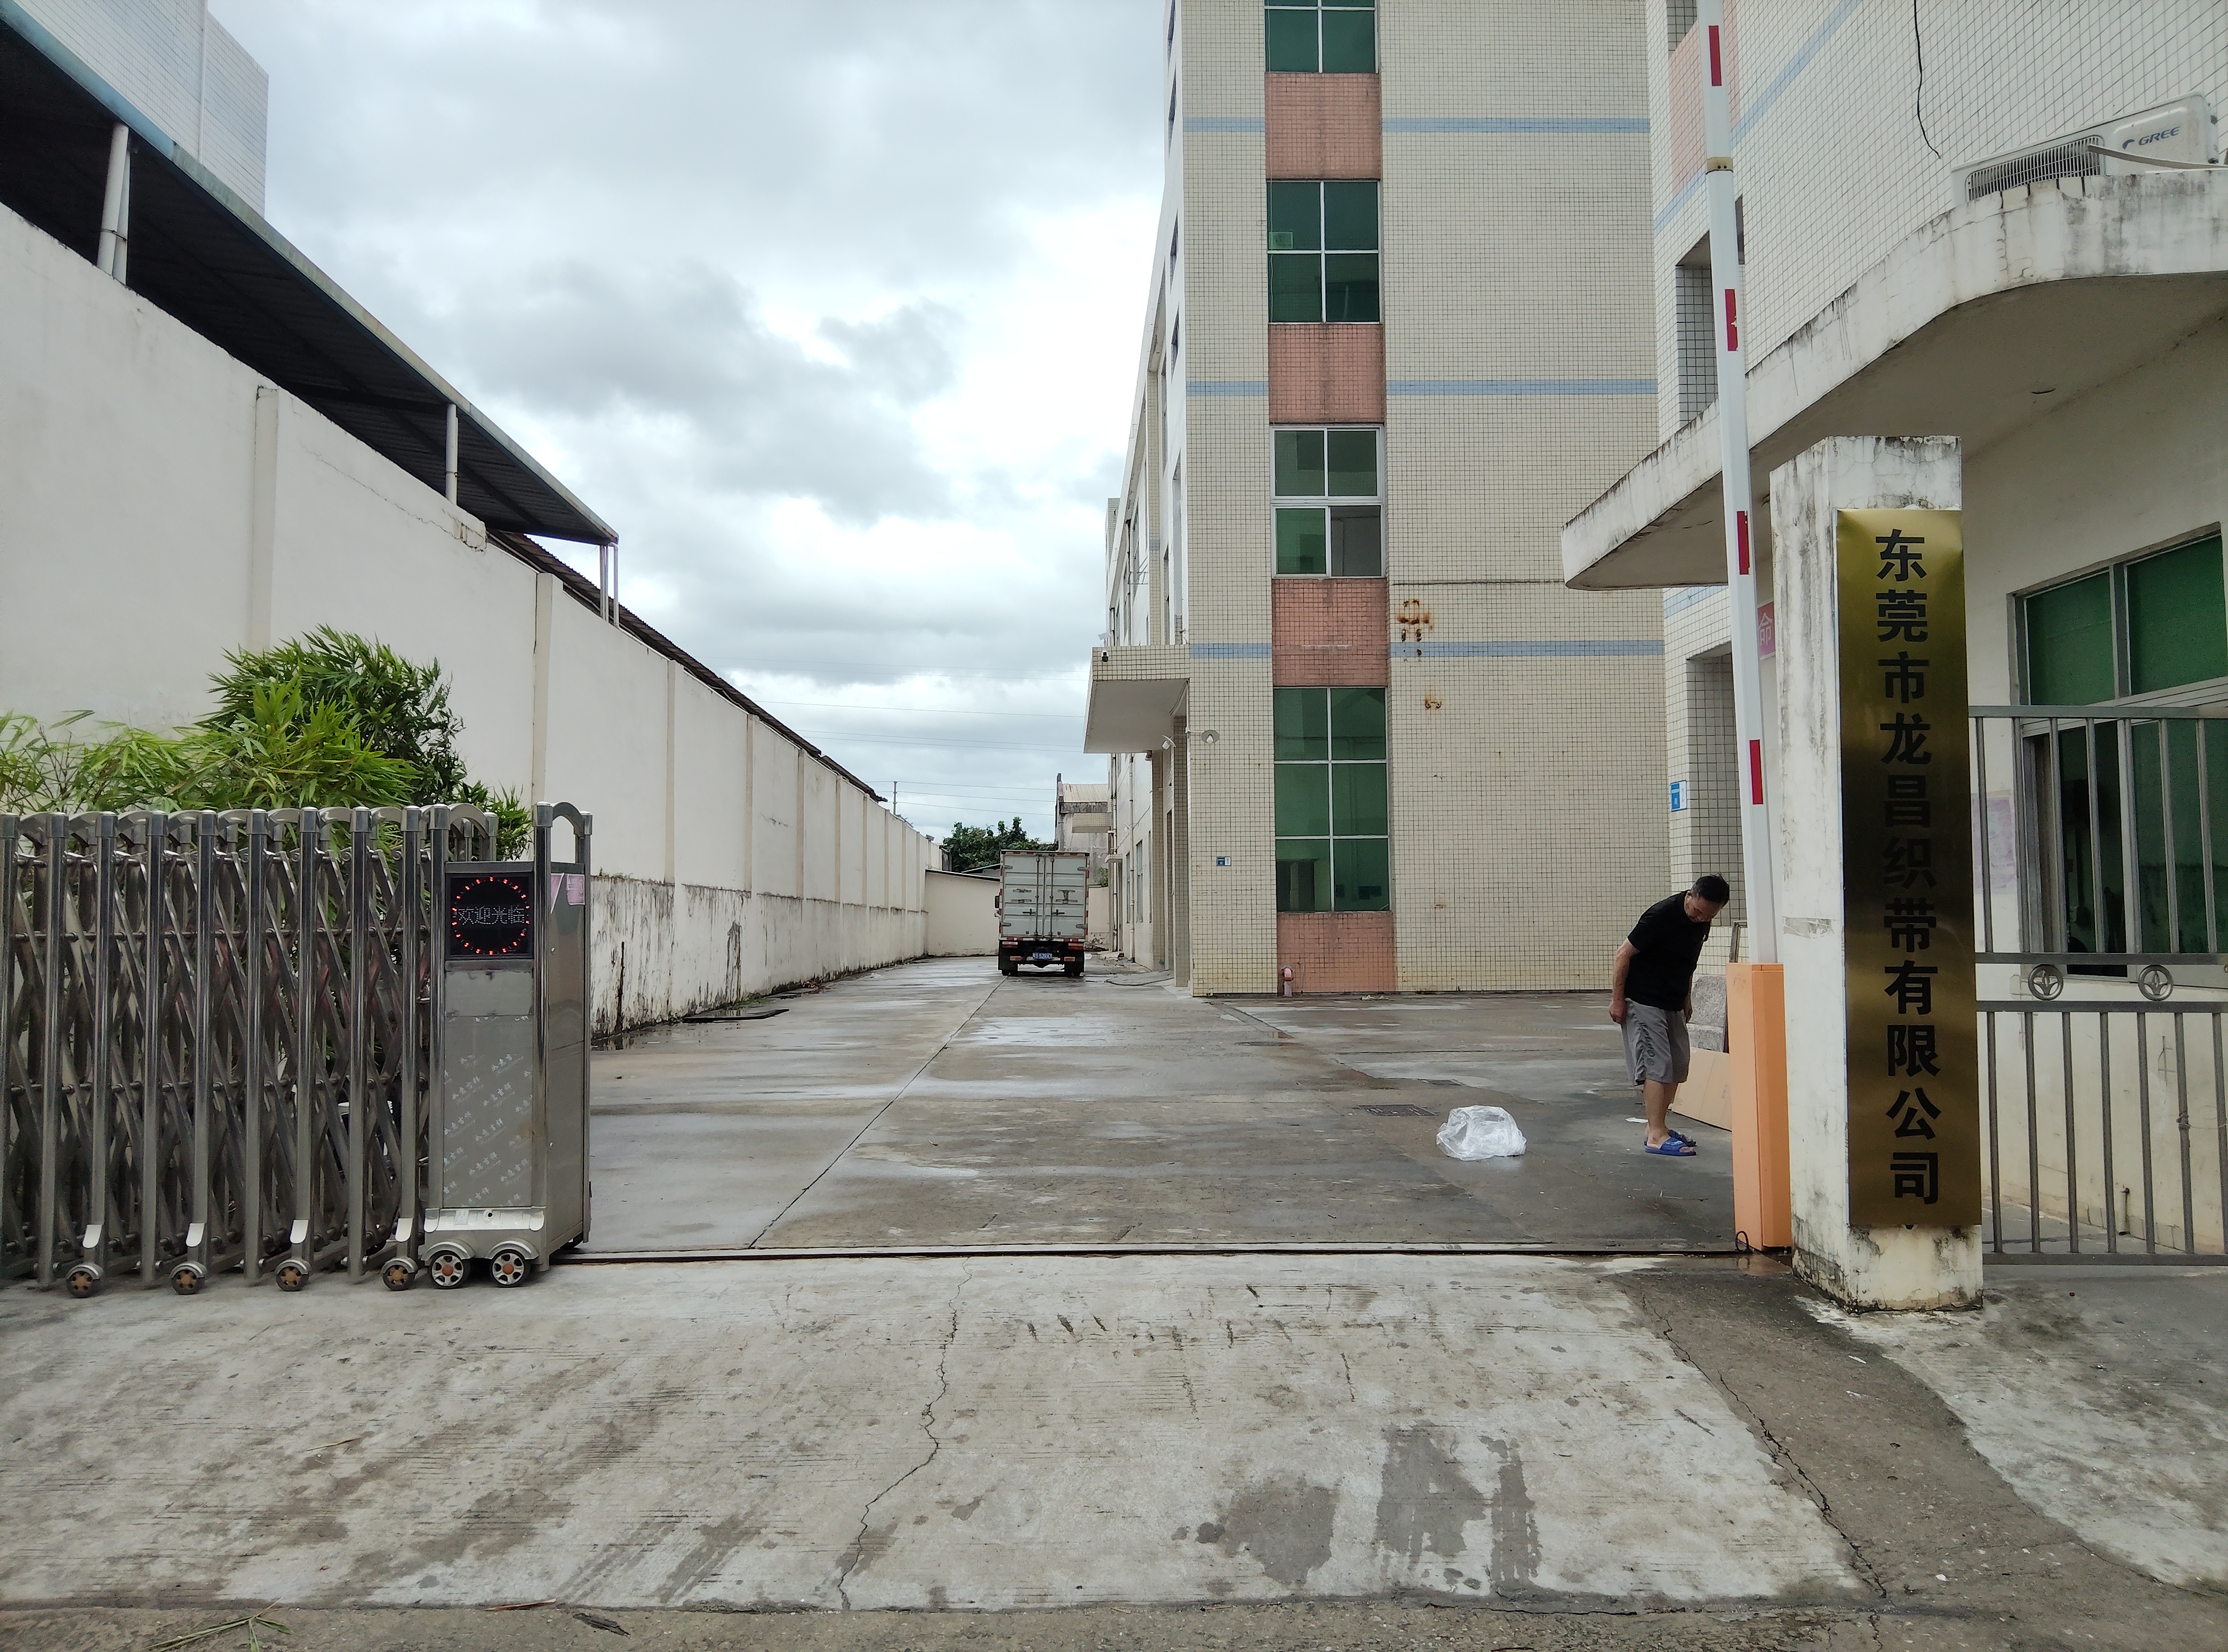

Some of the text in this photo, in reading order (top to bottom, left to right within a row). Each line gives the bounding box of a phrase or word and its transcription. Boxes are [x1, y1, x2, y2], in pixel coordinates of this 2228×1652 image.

[2139, 127, 2180, 146] GREE
[1758, 612, 1773, 646] 命
[1875, 528, 1942, 1205] 东莞市龙昌织带有限公司
[458, 905, 525, 925] 欢迎光临
